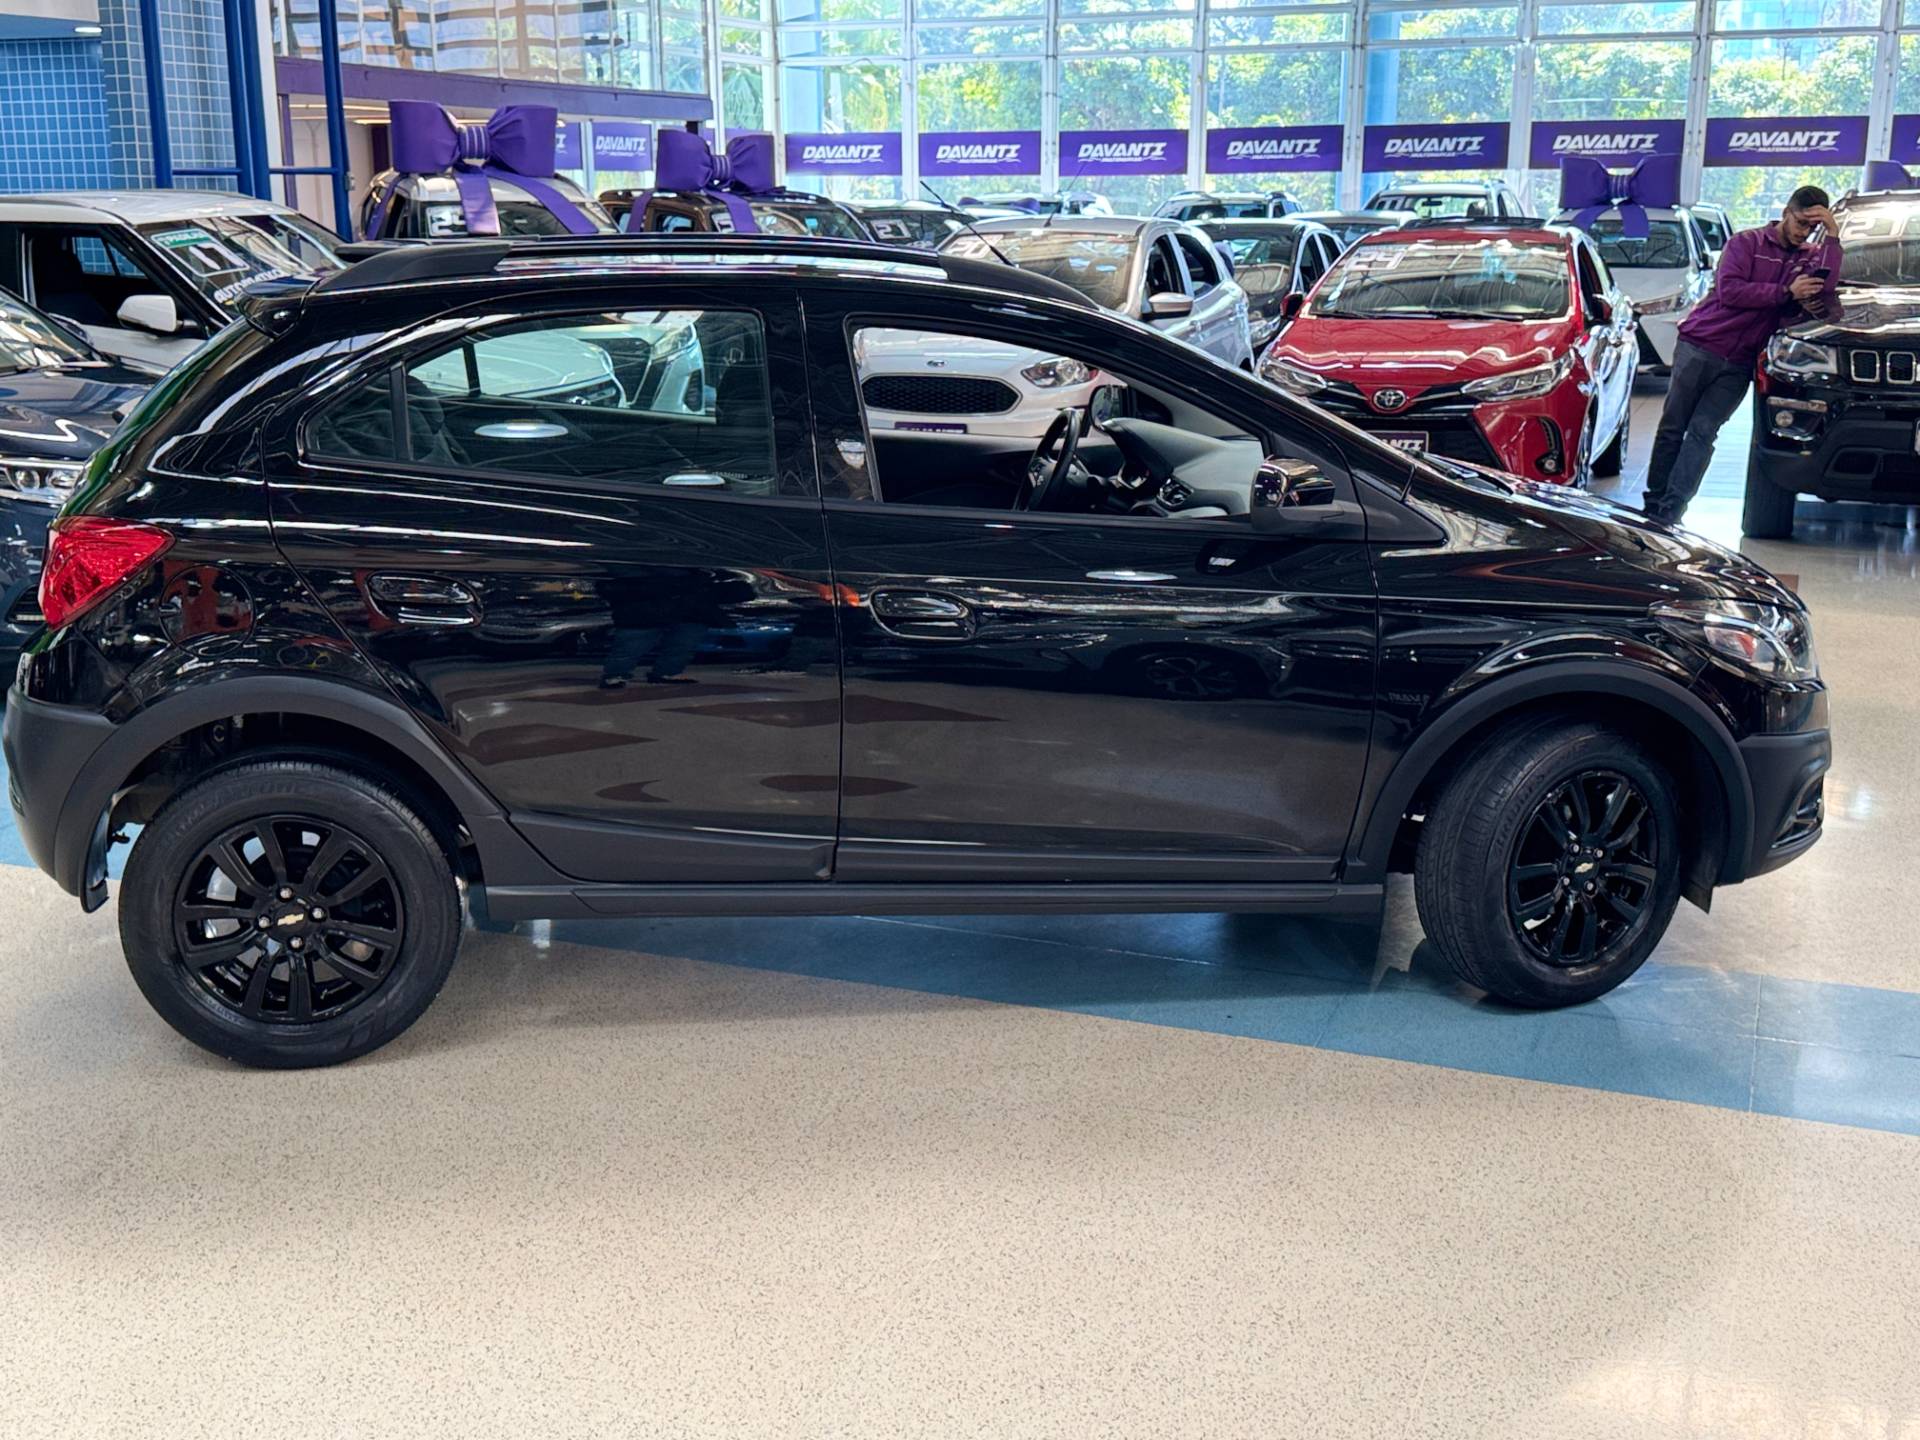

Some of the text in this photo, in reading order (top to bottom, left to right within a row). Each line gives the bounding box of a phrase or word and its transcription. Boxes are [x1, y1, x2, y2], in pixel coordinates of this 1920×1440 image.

[595, 135, 646, 151] DAVANTI
[1384, 136, 1485, 154] DAVANTI
[1552, 133, 1659, 150] DAVANTI
[1728, 130, 1841, 147] DAVANTI
[802, 144, 884, 159] DAVANTI
[936, 144, 1021, 159] DAVANTI
[1078, 142, 1167, 158] DAVANTI
[1227, 138, 1321, 156] DAVANTI
